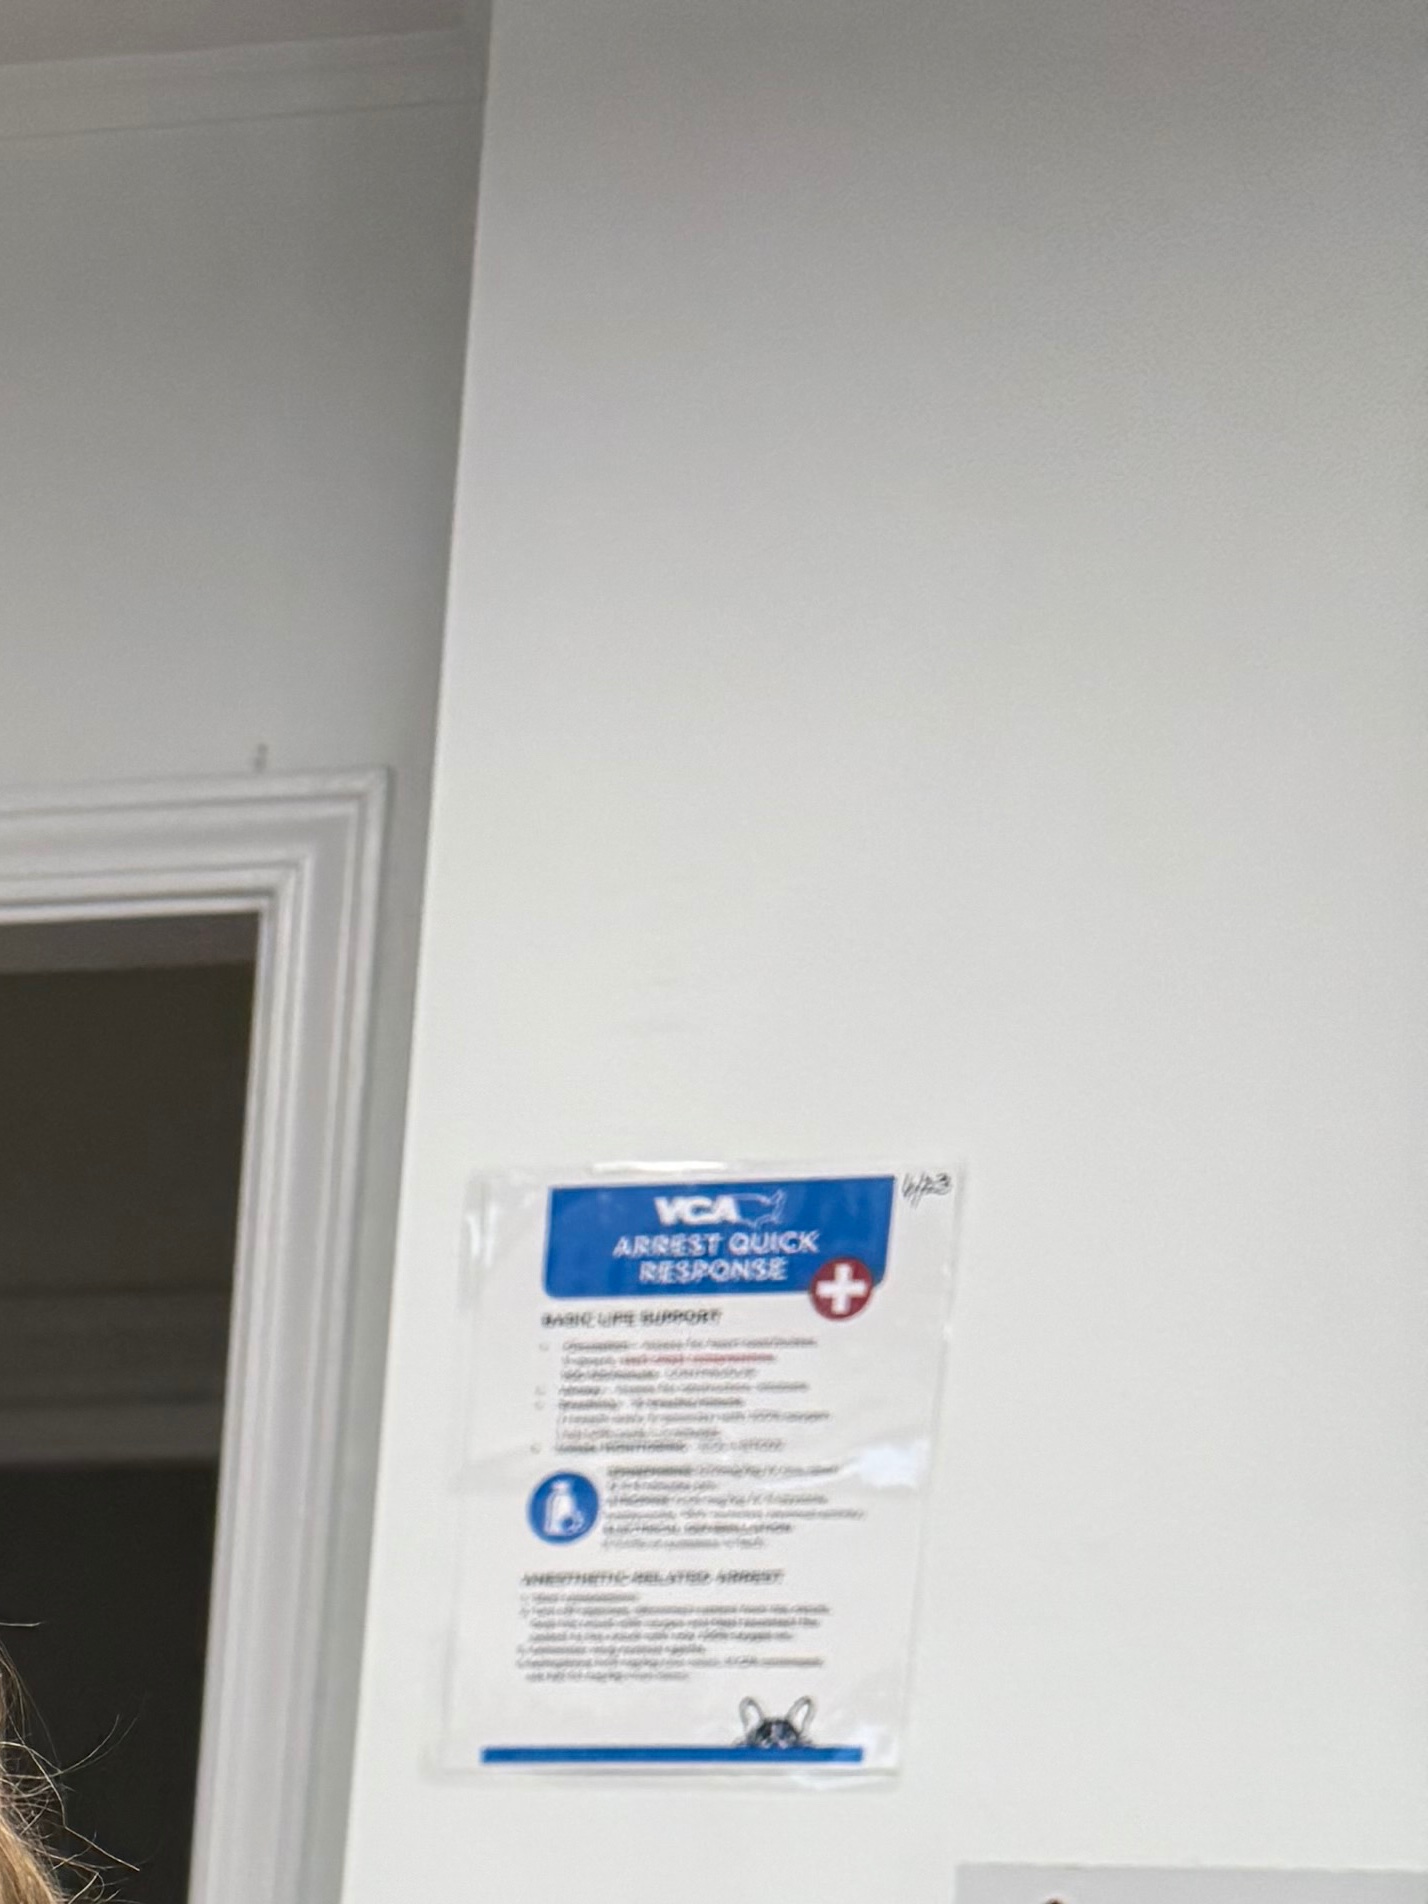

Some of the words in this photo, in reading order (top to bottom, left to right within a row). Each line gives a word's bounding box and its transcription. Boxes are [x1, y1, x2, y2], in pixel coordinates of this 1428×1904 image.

[654, 1195, 741, 1226] VCA
[612, 1232, 722, 1258] ARREST
[728, 1229, 820, 1256] QUICK
[638, 1256, 789, 1285] RESPONSE
